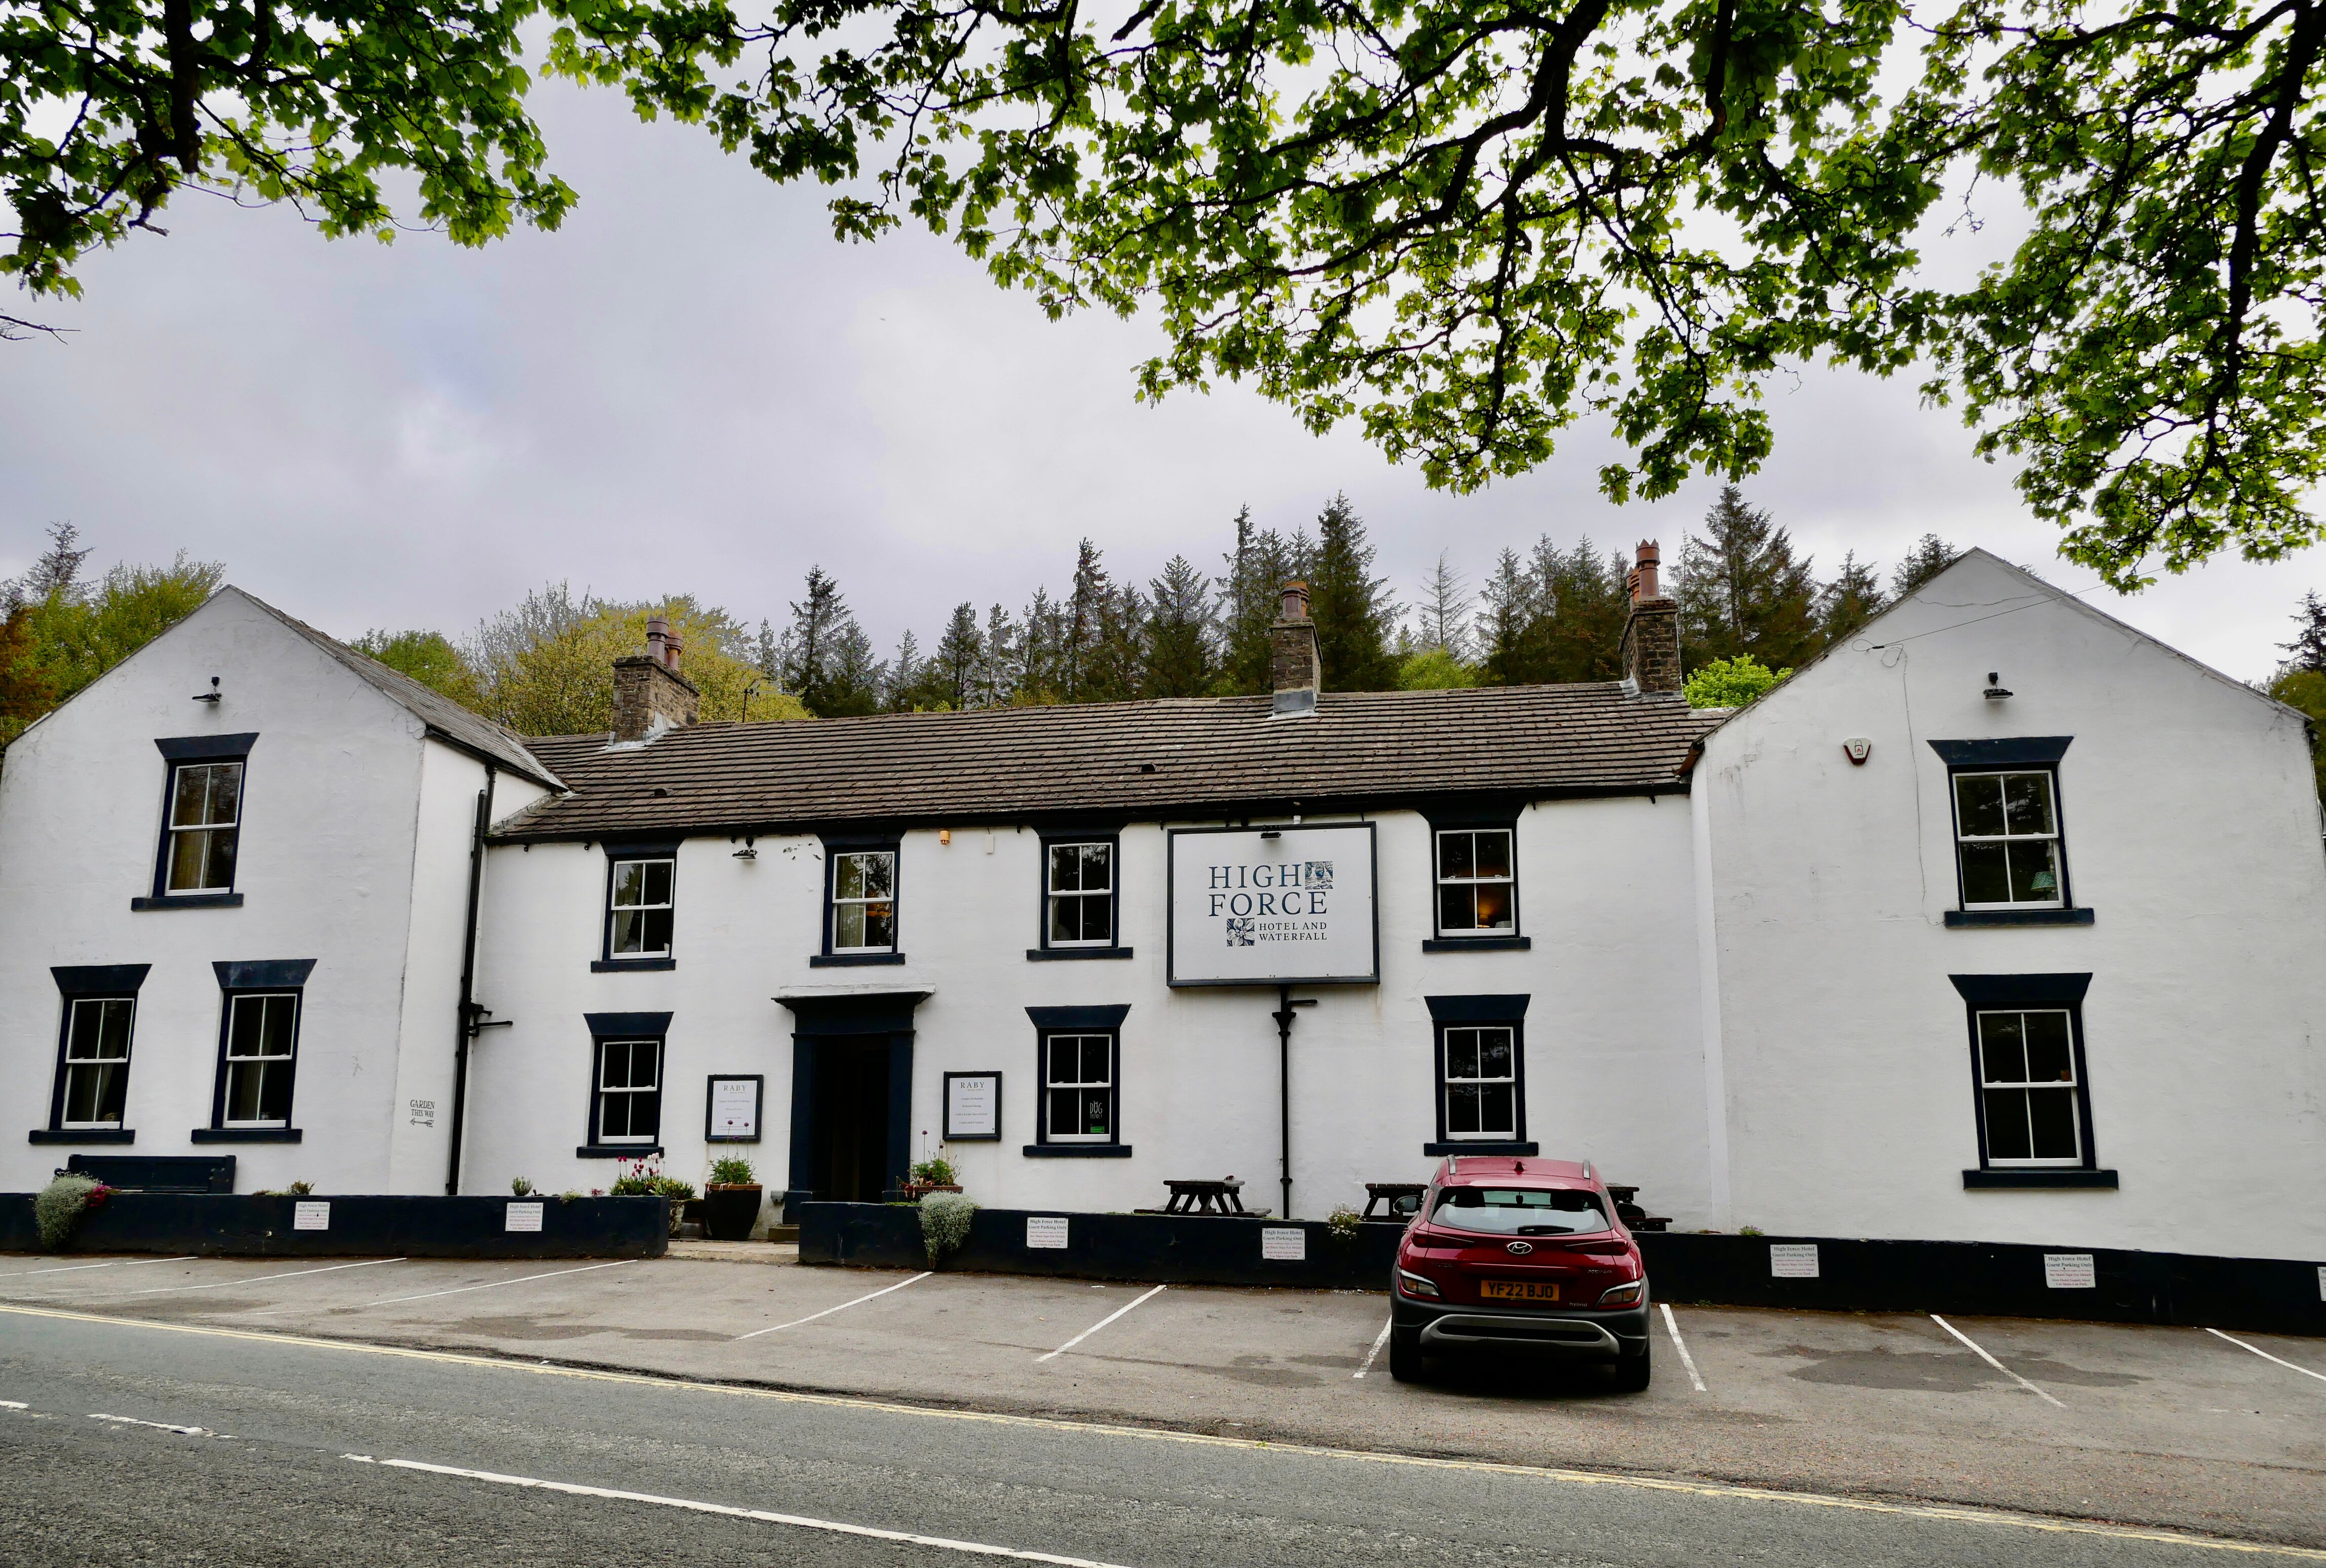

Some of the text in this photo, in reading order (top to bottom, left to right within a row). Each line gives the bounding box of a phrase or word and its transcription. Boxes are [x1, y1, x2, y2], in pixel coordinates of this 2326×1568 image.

[1209, 864, 1301, 889] HIGH
[1209, 891, 1327, 916] FORCE
[1259, 922, 1327, 931] HOTEL AND
[1259, 932, 1327, 941] WATERFALL
[410, 1099, 435, 1109] GARDEN
[1090, 1102, 1103, 1114] DOG
[1488, 1281, 1554, 1298] YF22 BJO
